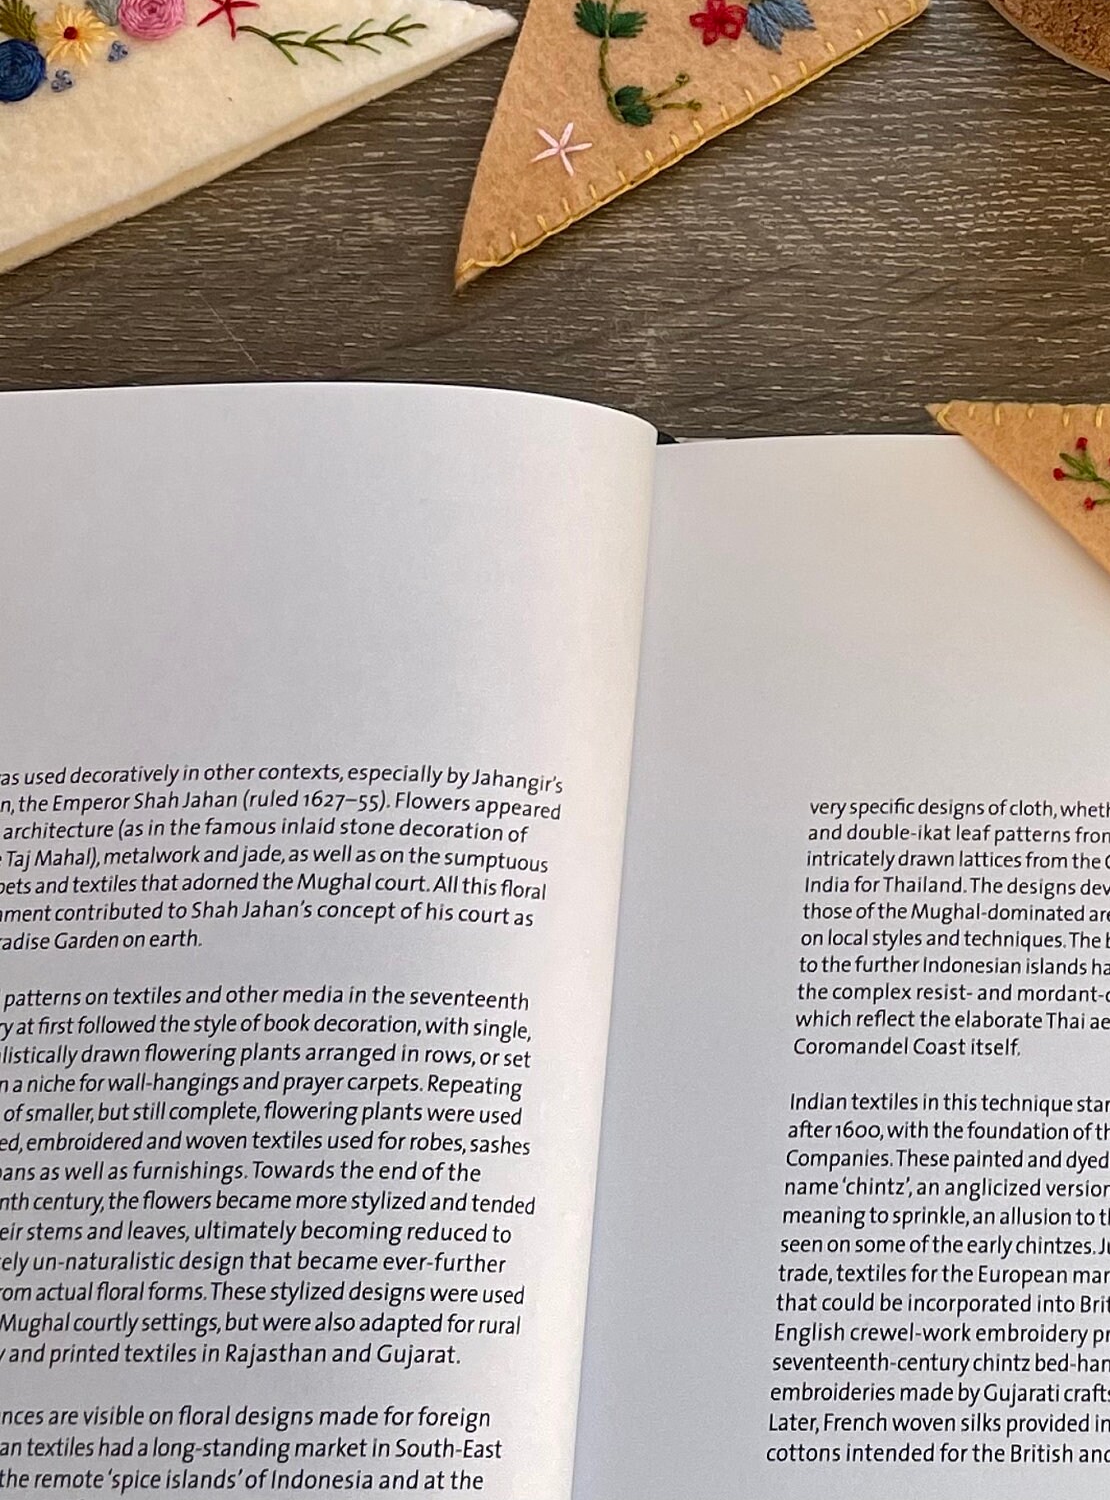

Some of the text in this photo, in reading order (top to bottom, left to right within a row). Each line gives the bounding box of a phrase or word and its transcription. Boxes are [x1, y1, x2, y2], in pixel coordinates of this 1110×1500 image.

[2, 816, 530, 844] architecture (as in the famous inlaid stone decoration of
[806, 848, 896, 873] intricately
[897, 848, 955, 868] drawn
[958, 849, 1022, 869] lattices
[1024, 850, 1068, 869] from
[1071, 851, 1102, 870] the
[800, 933, 824, 947] on
[827, 927, 869, 946] local
[871, 928, 923, 952] styles
[925, 928, 961, 947] and
[963, 929, 1067, 954] techniques.
[1068, 930, 1102, 949] The
[2, 983, 529, 1013] patterns on textiles and other media in the seventeenth
[796, 981, 829, 1001] the
[832, 981, 913, 1006] complex
[916, 982, 974, 1001] resist-
[976, 982, 1013, 1002] and
[793, 1035, 1022, 1057] Coromandel Coast itself.
[3, 1099, 523, 1127] of smaller, but still complete, flowering plants were used
[790, 1091, 848, 1111] Indian
[850, 1091, 919, 1111] textiles
[922, 1092, 939, 1111] in
[942, 1092, 978, 1112] this
[980, 1092, 1074, 1118] technique
[25, 1129, 145, 1152] embroidered
[145, 1129, 183, 1151] and
[185, 1134, 248, 1150] woven
[250, 1129, 323, 1150] textiles
[327, 1129, 375, 1150] used
[377, 1130, 407, 1151] for
[409, 1131, 467, 1156] robes,
[469, 1134, 531, 1156] sashes
[775, 1291, 818, 1313] that
[821, 1291, 875, 1312] could
[879, 1291, 903, 1313] be
[907, 1292, 1032, 1319] incorporated
[1037, 1294, 1076, 1314] into
[0, 1310, 522, 1339] Mughal courtly settings, but were also adapted for rural
[768, 1412, 820, 1436] Later,
[823, 1411, 888, 1432] French
[891, 1417, 956, 1433] woven
[960, 1411, 1002, 1433] silks
[1005, 1412, 1090, 1439] provided
[26, 1435, 95, 1458] textiles
[97, 1435, 135, 1458] had
[137, 1441, 149, 1458] a
[152, 1435, 291, 1464] long-standing
[294, 1436, 369, 1459] market
[371, 1437, 391, 1458] in
[394, 1437, 503, 1459] South-East
[766, 1443, 841, 1463] cottons
[845, 1441, 935, 1463] intended
[938, 1441, 969, 1463] for
[971, 1442, 1006, 1463] the
[1010, 1442, 1074, 1464] British
[0, 1467, 30, 1489] the
[33, 1469, 105, 1490] remote
[244, 1467, 270, 1490] of
[270, 1467, 374, 1491] Indonesia
[378, 1468, 420, 1491] and
[423, 1470, 446, 1491] at
[449, 1468, 484, 1491] the
